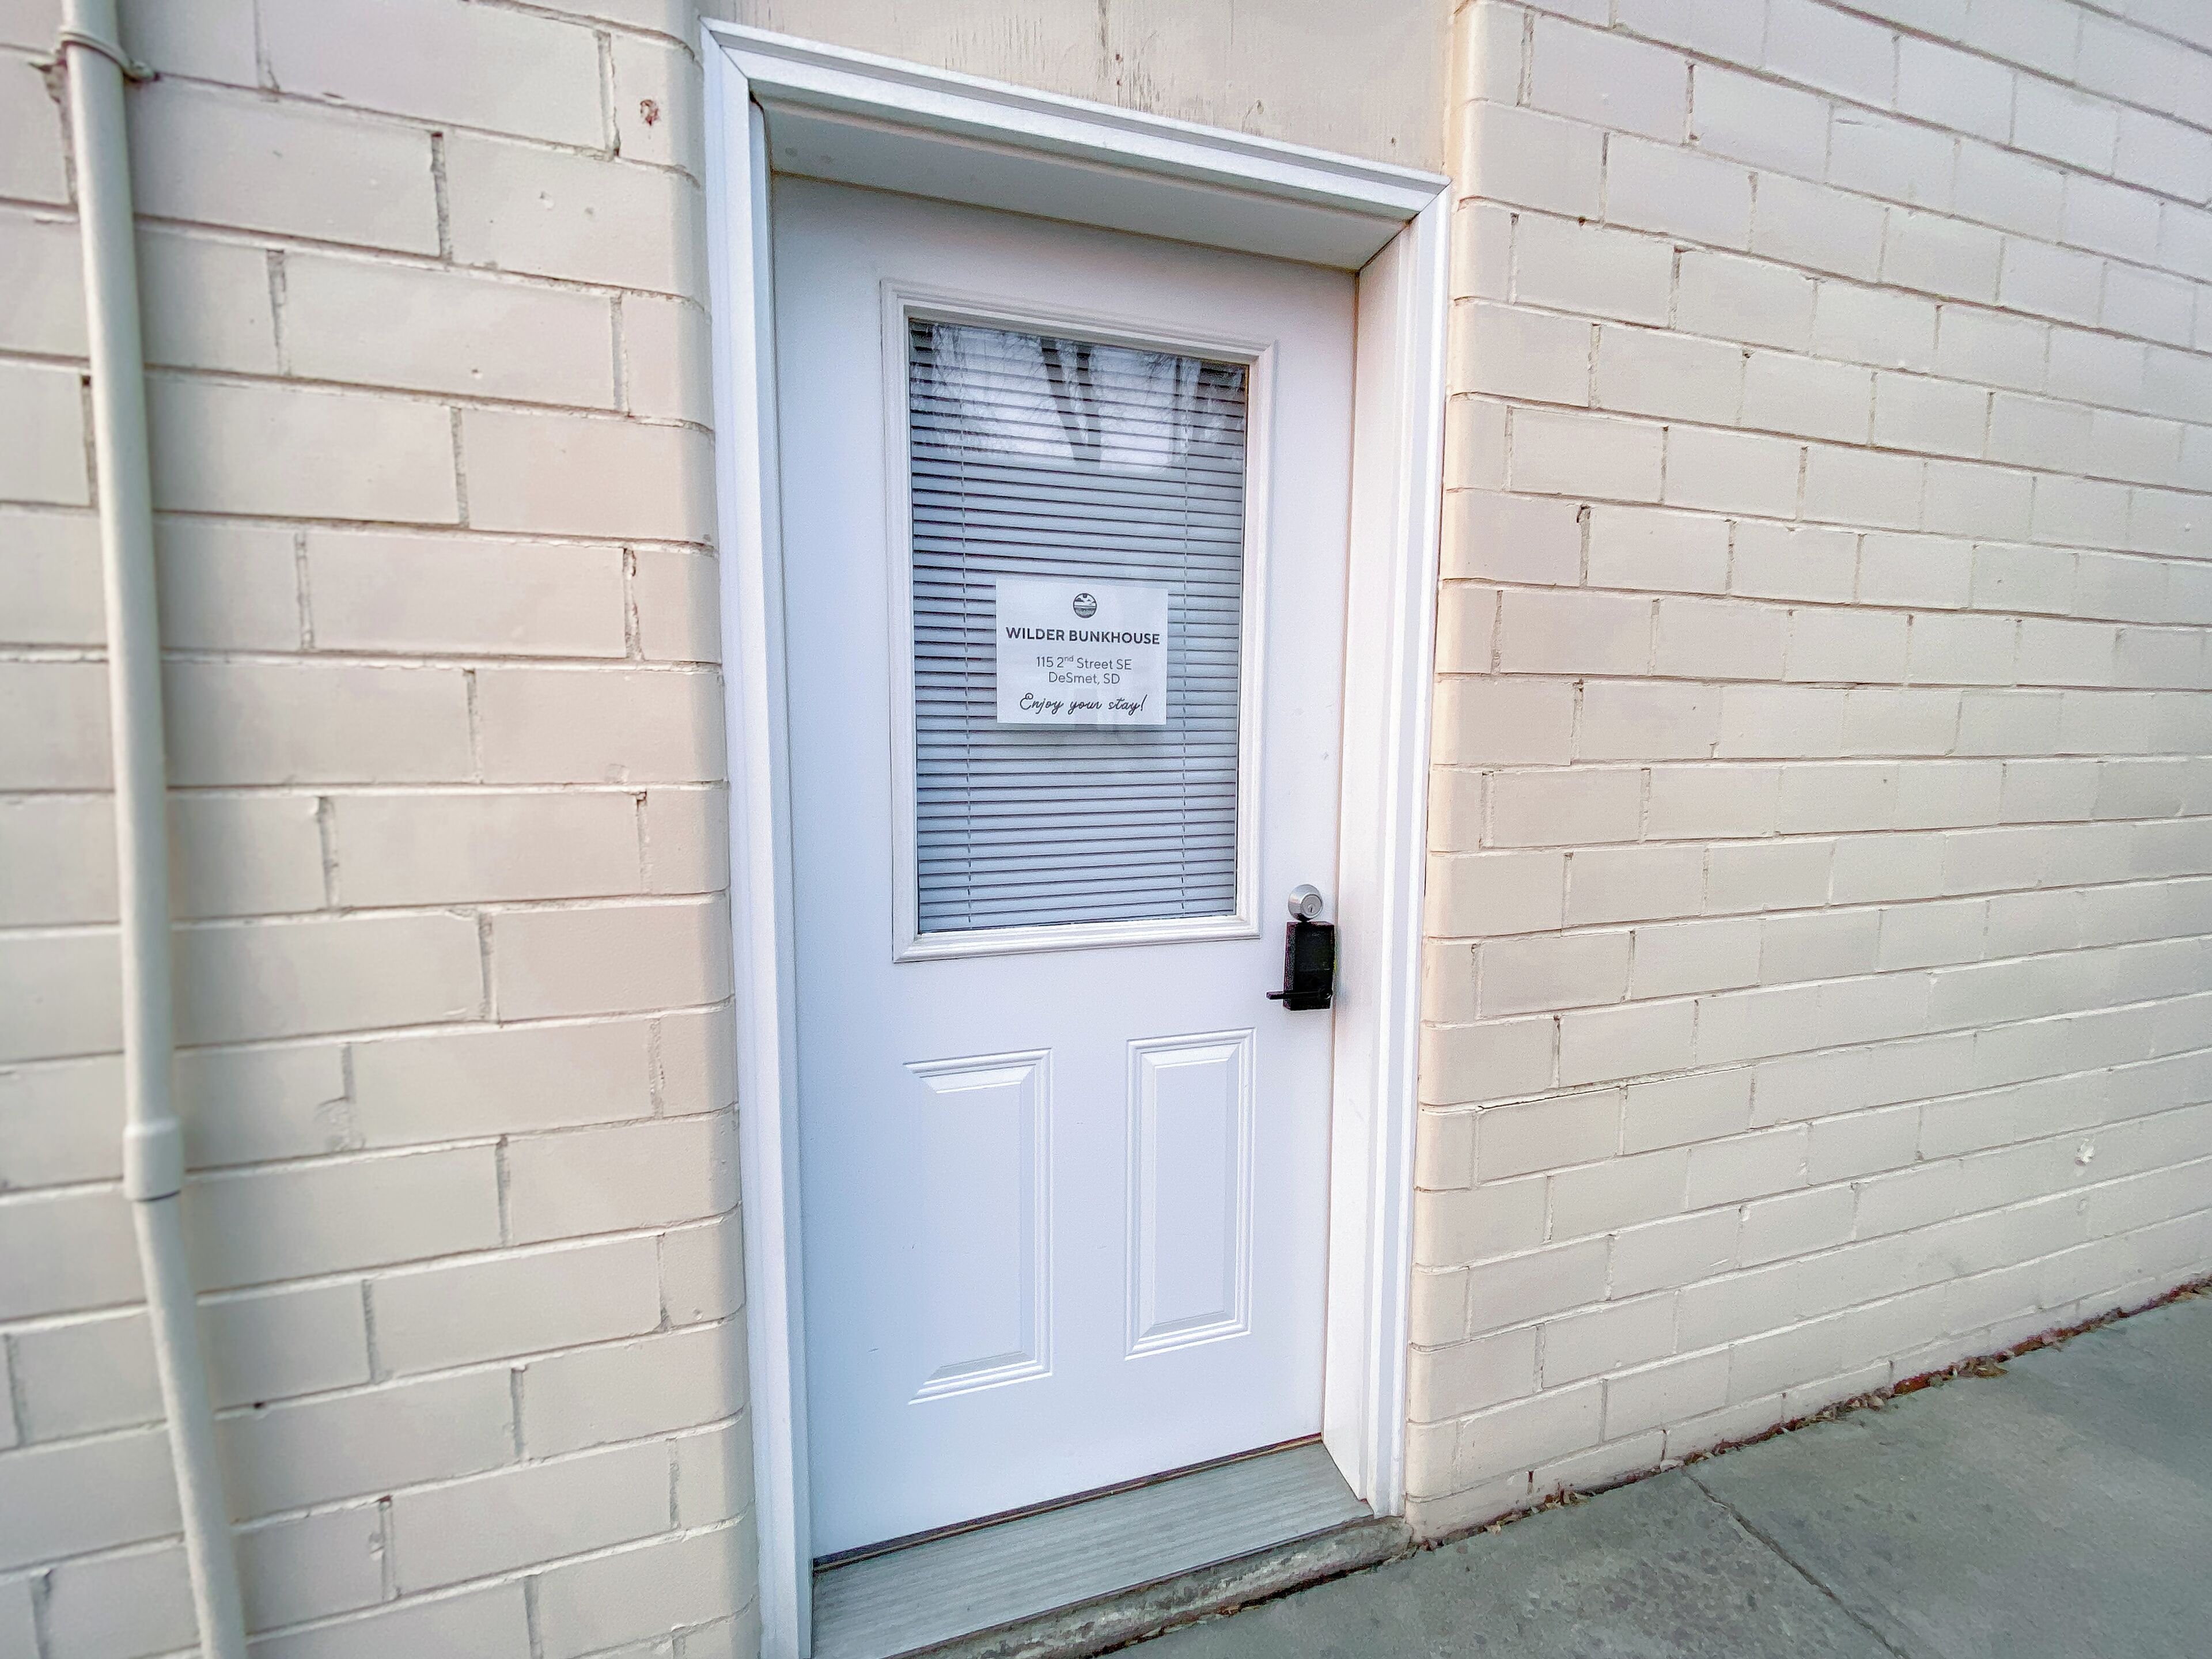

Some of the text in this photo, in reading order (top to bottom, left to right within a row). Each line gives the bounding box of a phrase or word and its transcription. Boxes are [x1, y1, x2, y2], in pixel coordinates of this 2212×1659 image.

[1006, 627, 1160, 645] WILDER BUNKHOUSE
[1036, 656, 1132, 670] 115 2nd Street SE
[1049, 672, 1120, 685] DeSmet, SD
[1020, 693, 1147, 715] Enjoy your stay!
